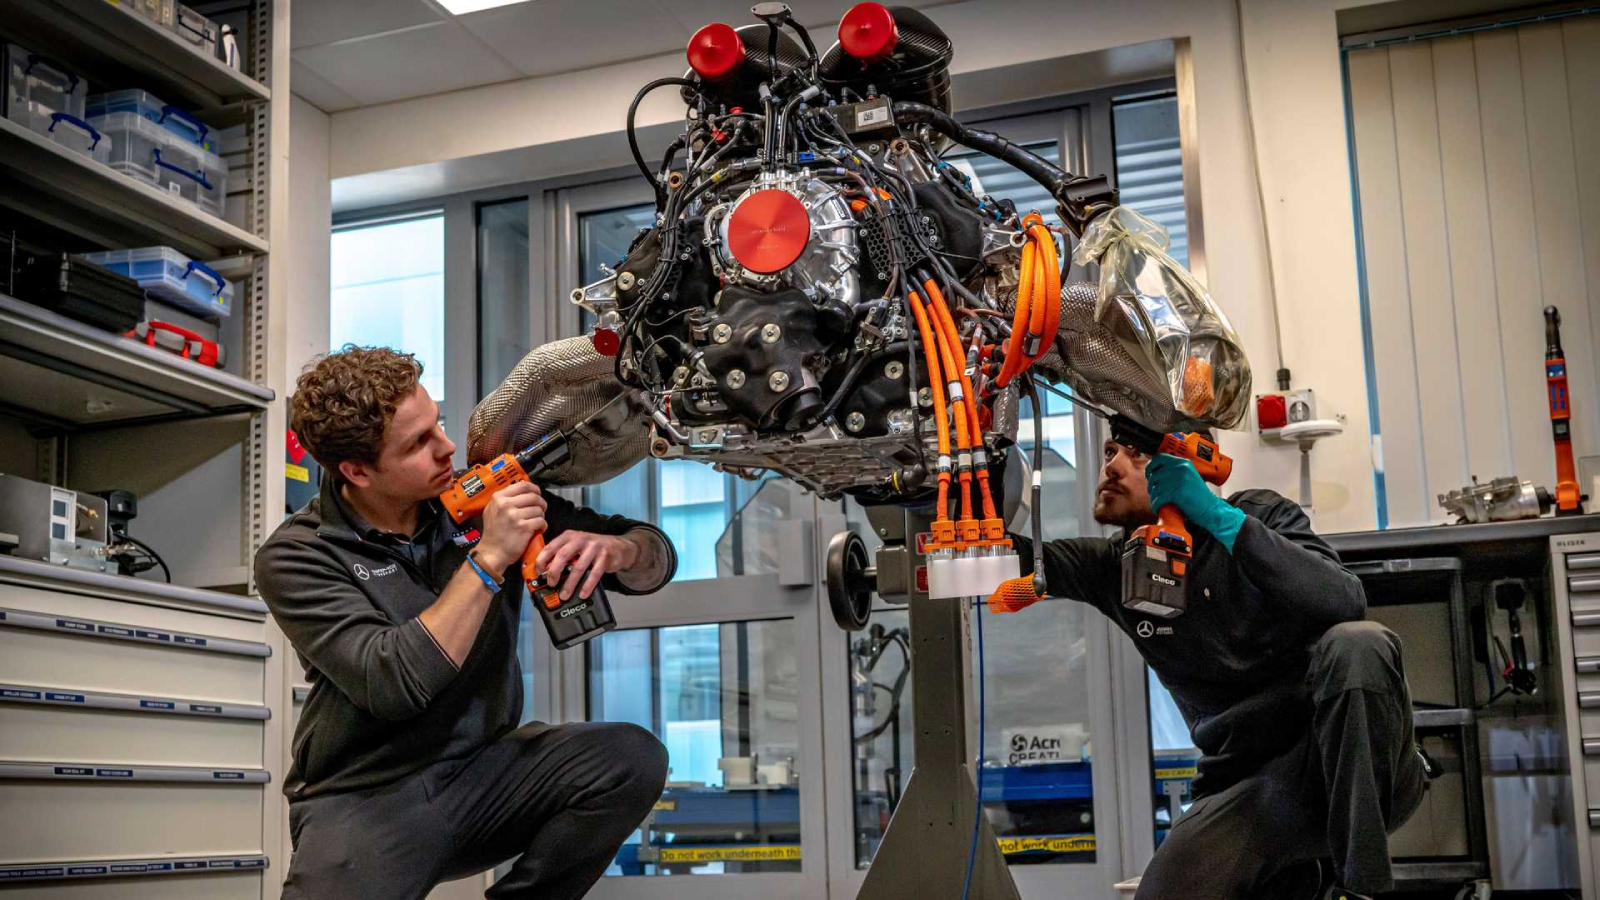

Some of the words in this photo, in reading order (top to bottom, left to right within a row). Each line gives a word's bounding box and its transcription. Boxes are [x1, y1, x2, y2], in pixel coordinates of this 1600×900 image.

[1152, 574, 1175, 585] Cleco
[560, 603, 587, 618] Cleco
[1001, 839, 1020, 851] not
[1022, 840, 1050, 850] work
[661, 850, 675, 860] Do
[678, 850, 694, 860] not
[697, 849, 720, 860] work
[725, 848, 785, 859] underneath
